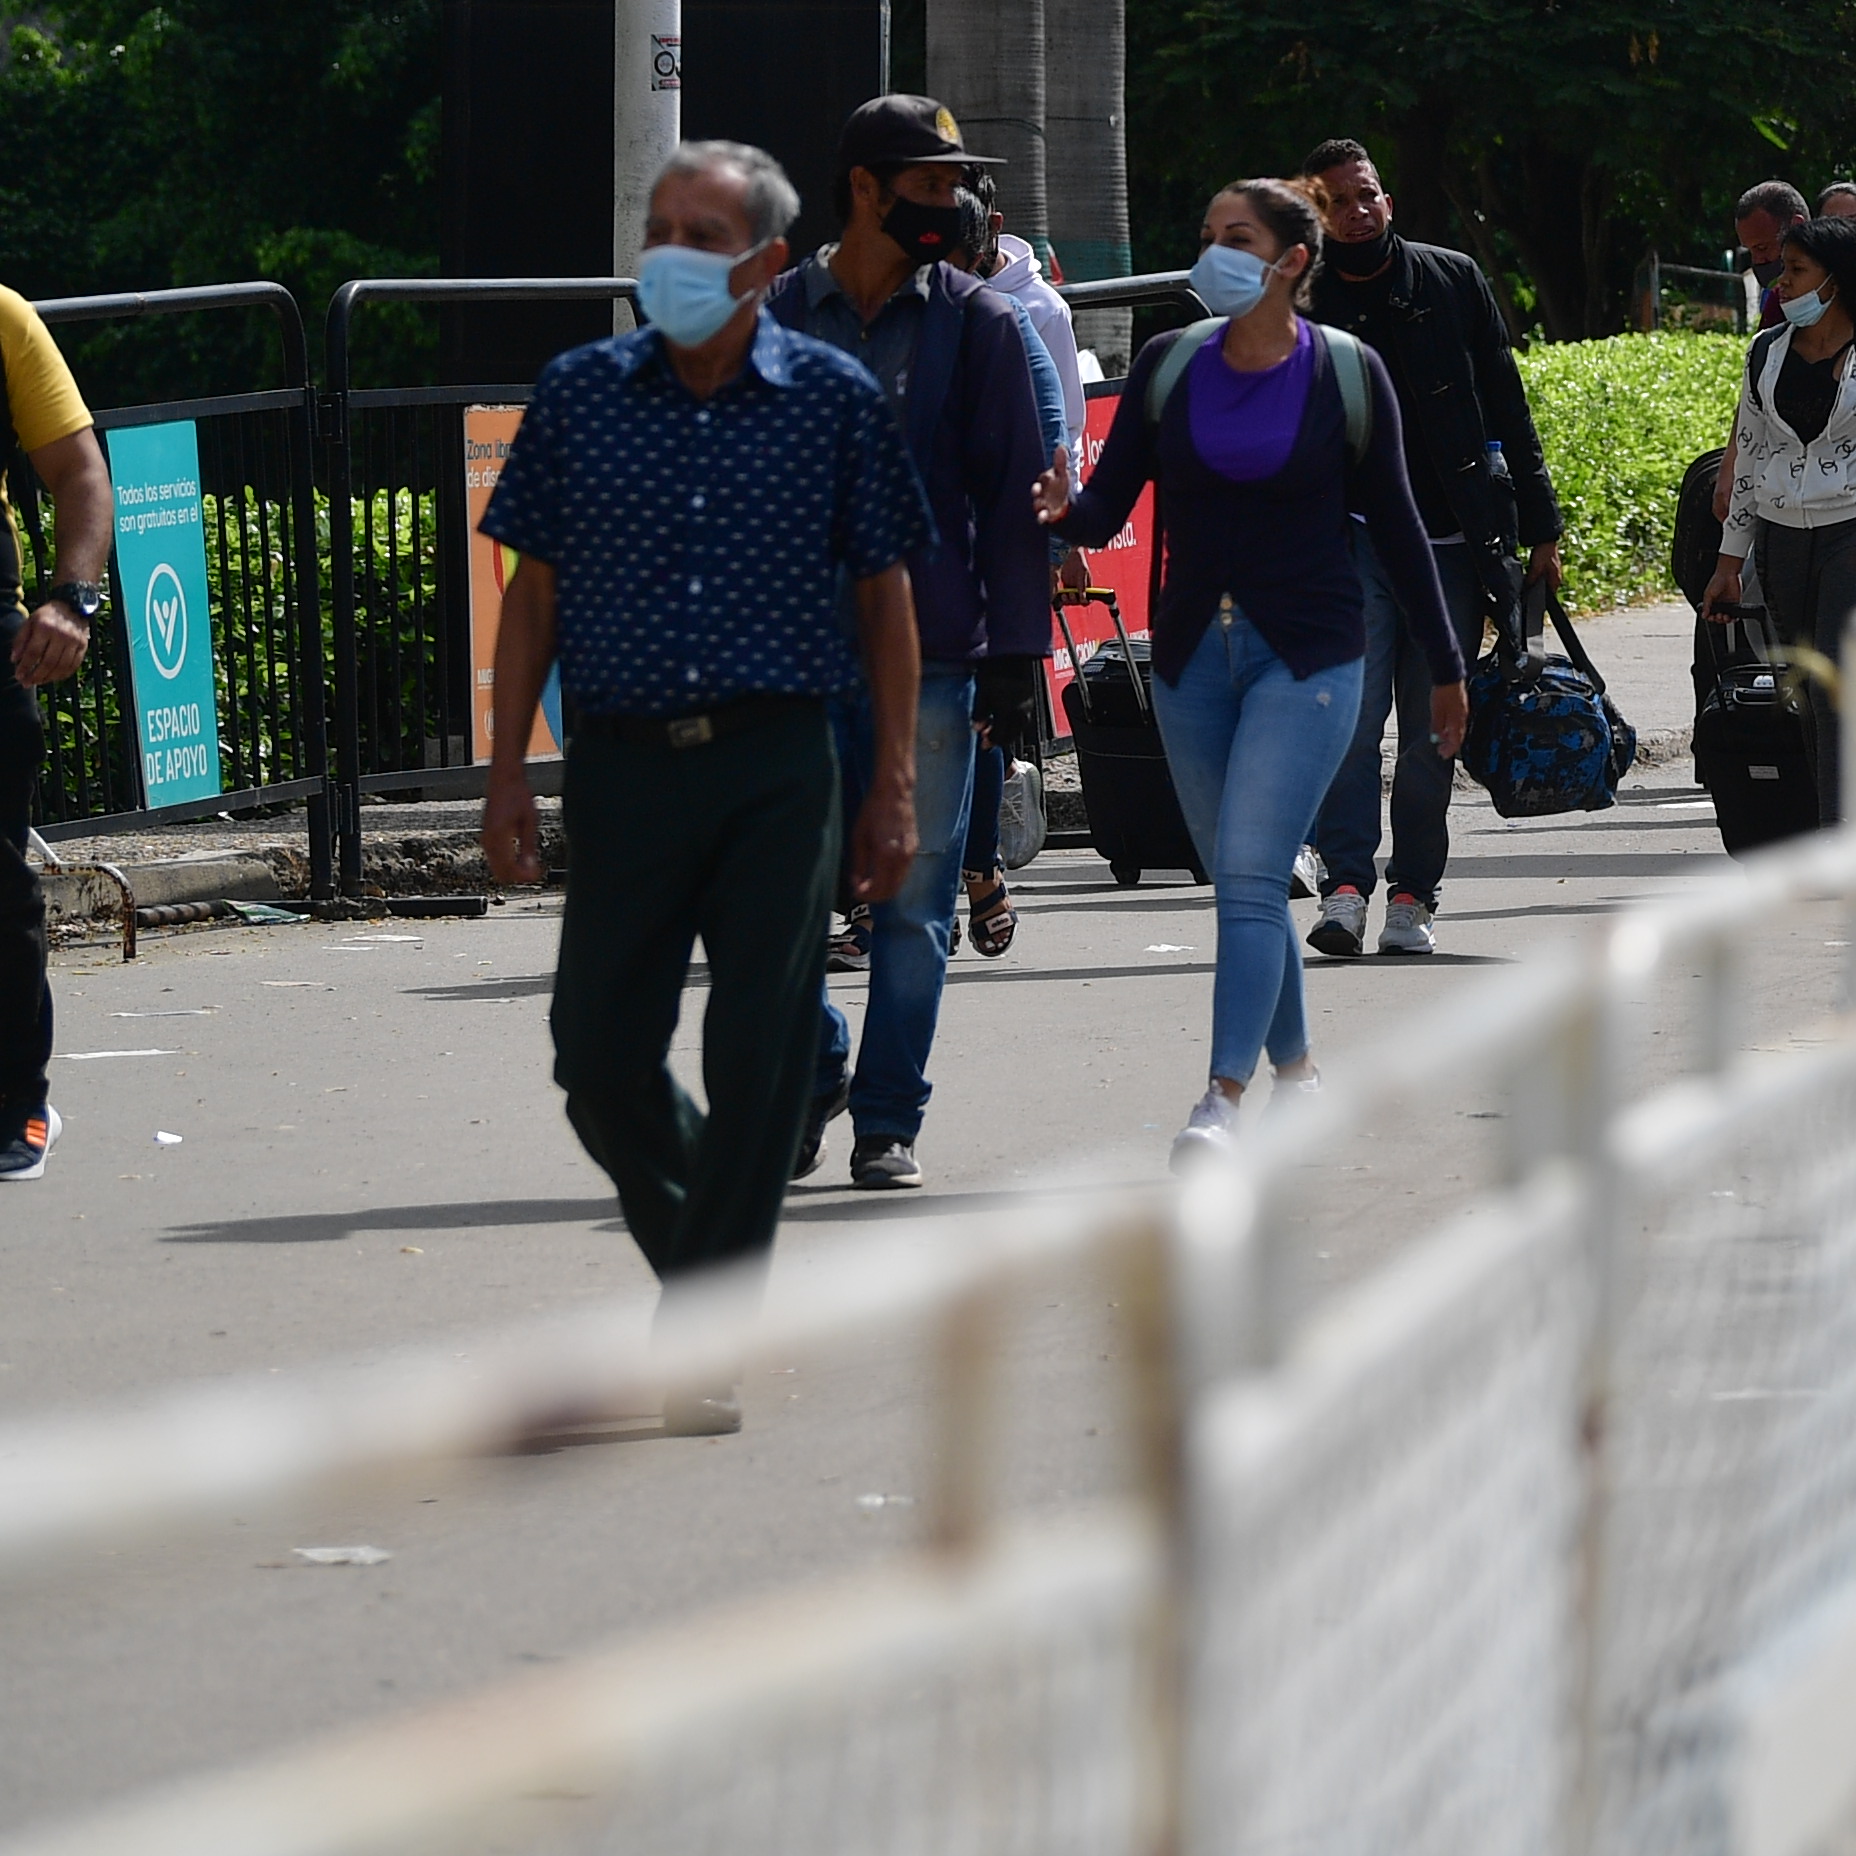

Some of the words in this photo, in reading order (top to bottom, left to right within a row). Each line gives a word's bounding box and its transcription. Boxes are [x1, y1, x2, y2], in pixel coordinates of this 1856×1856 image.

[467, 439, 492, 460] Zona
[117, 483, 144, 506] Todos
[145, 481, 158, 502] los
[159, 477, 197, 500] servicios
[467, 466, 481, 488] de
[119, 514, 136, 533] son
[137, 506, 177, 535] gratuitos
[178, 507, 189, 524] en
[190, 502, 199, 522] el
[147, 702, 200, 743] ESPACIO
[146, 750, 164, 786] DE
[164, 745, 208, 783] APOYO
